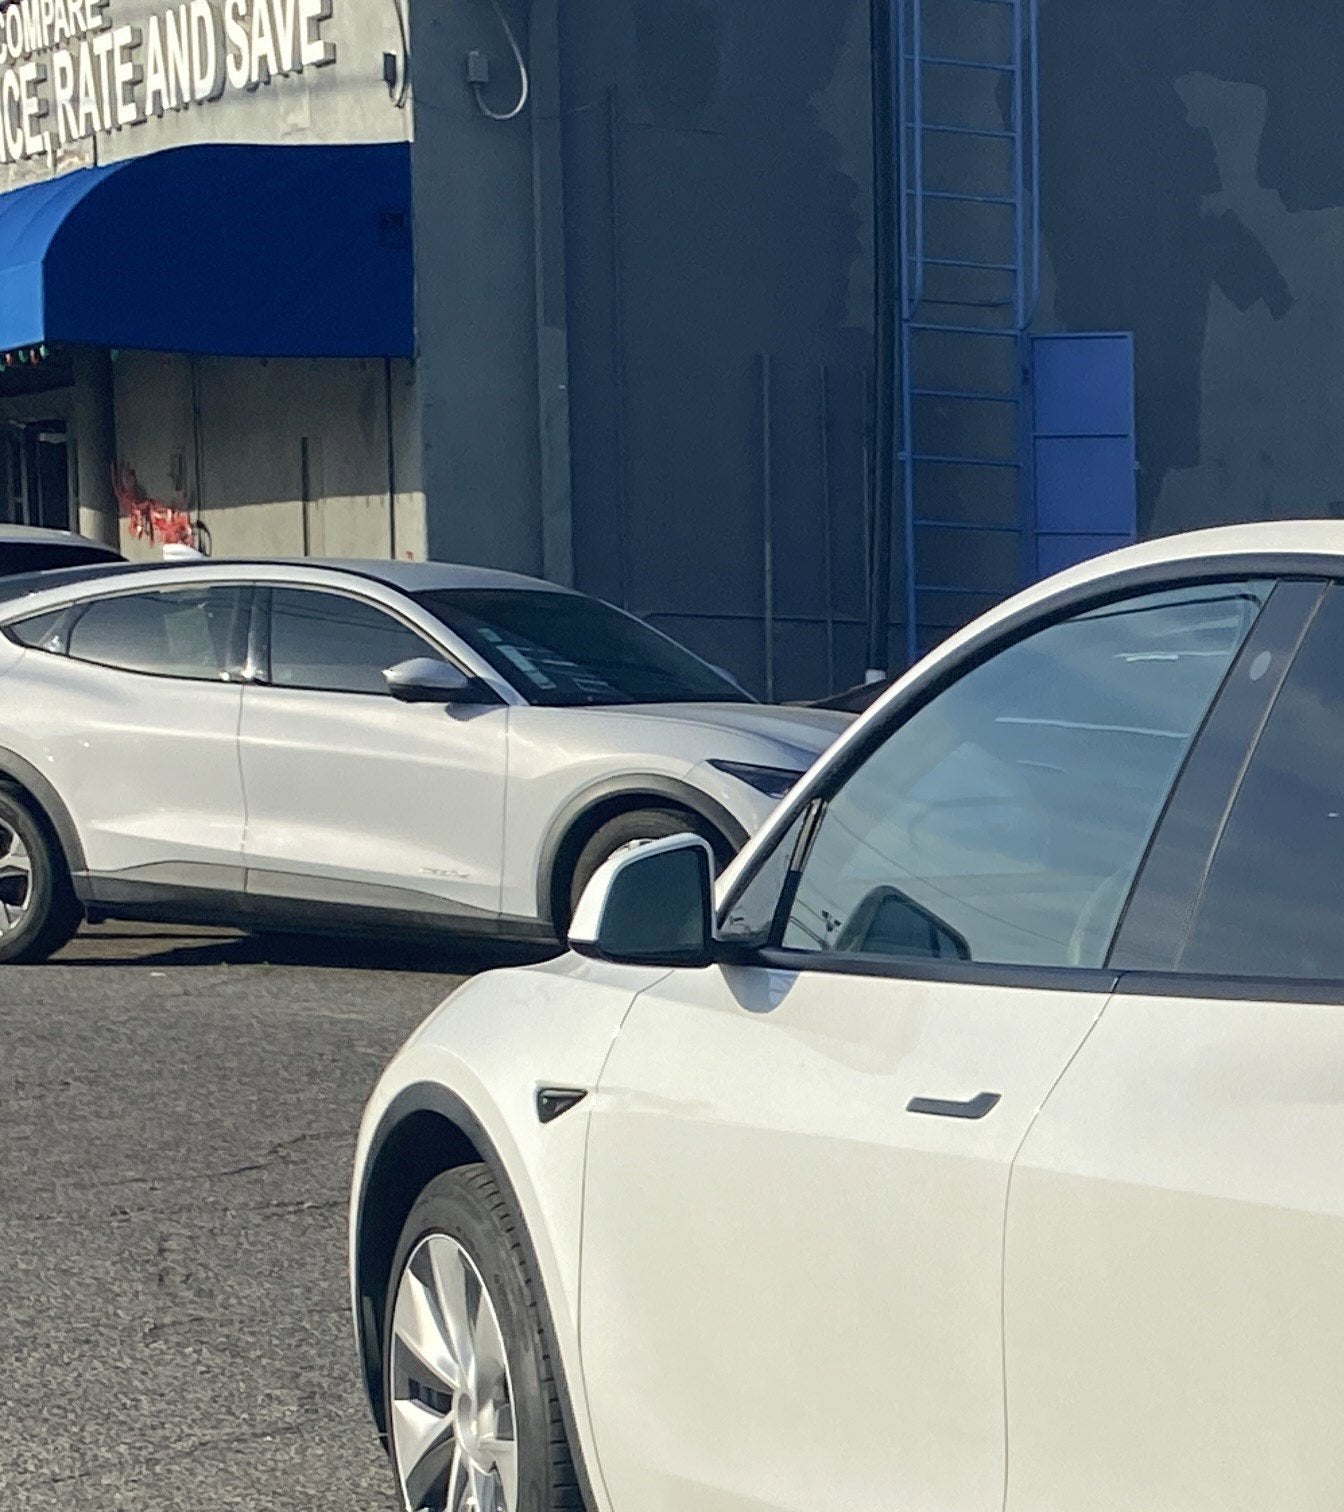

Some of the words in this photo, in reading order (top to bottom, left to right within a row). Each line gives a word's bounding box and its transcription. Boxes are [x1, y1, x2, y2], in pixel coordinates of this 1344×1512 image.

[0, 62, 51, 168] CE,
[53, 25, 137, 144] RATE
[145, 2, 217, 116] AND
[224, 0, 325, 89] SAVE
